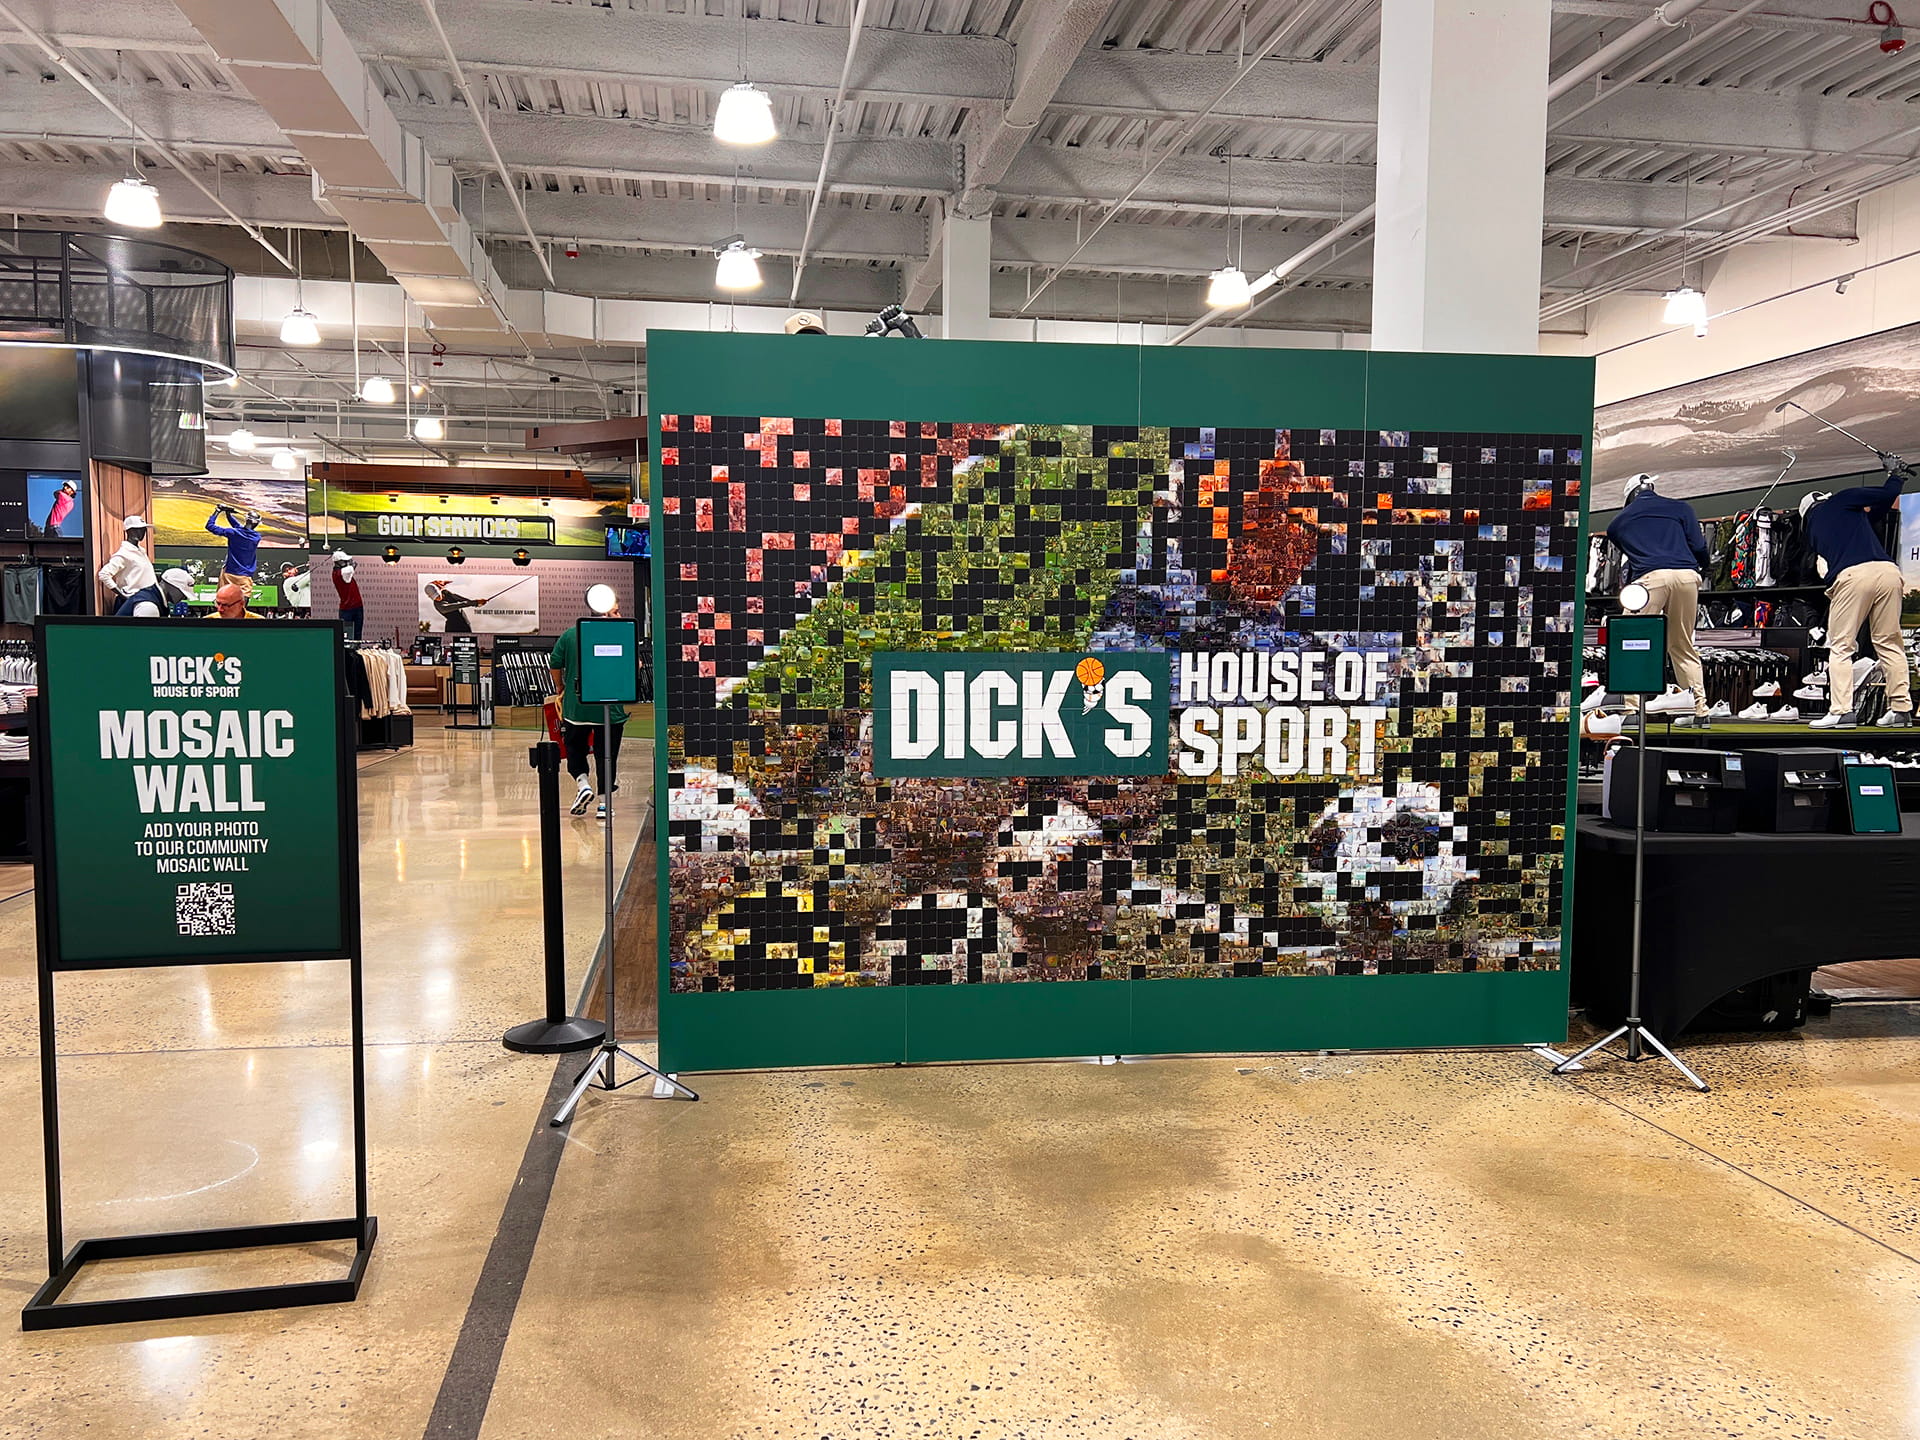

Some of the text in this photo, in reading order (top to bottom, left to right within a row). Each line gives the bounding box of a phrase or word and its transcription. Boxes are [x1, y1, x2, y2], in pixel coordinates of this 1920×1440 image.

[377, 514, 518, 538] GOLF SERVICES
[150, 653, 242, 685] DICK'S
[1180, 651, 1389, 702] HOUSE OF
[153, 686, 240, 698] HOUSE OF SPORT
[890, 657, 1152, 759] DICK'S
[99, 710, 294, 759] MOSAIC
[1179, 706, 1387, 777] SPORT
[133, 764, 266, 814] WALL
[144, 821, 259, 838] ADD YOUR PHOTO
[134, 838, 269, 856] TO OUR COMMUNITY
[156, 857, 249, 873] MOSAIC WALL
